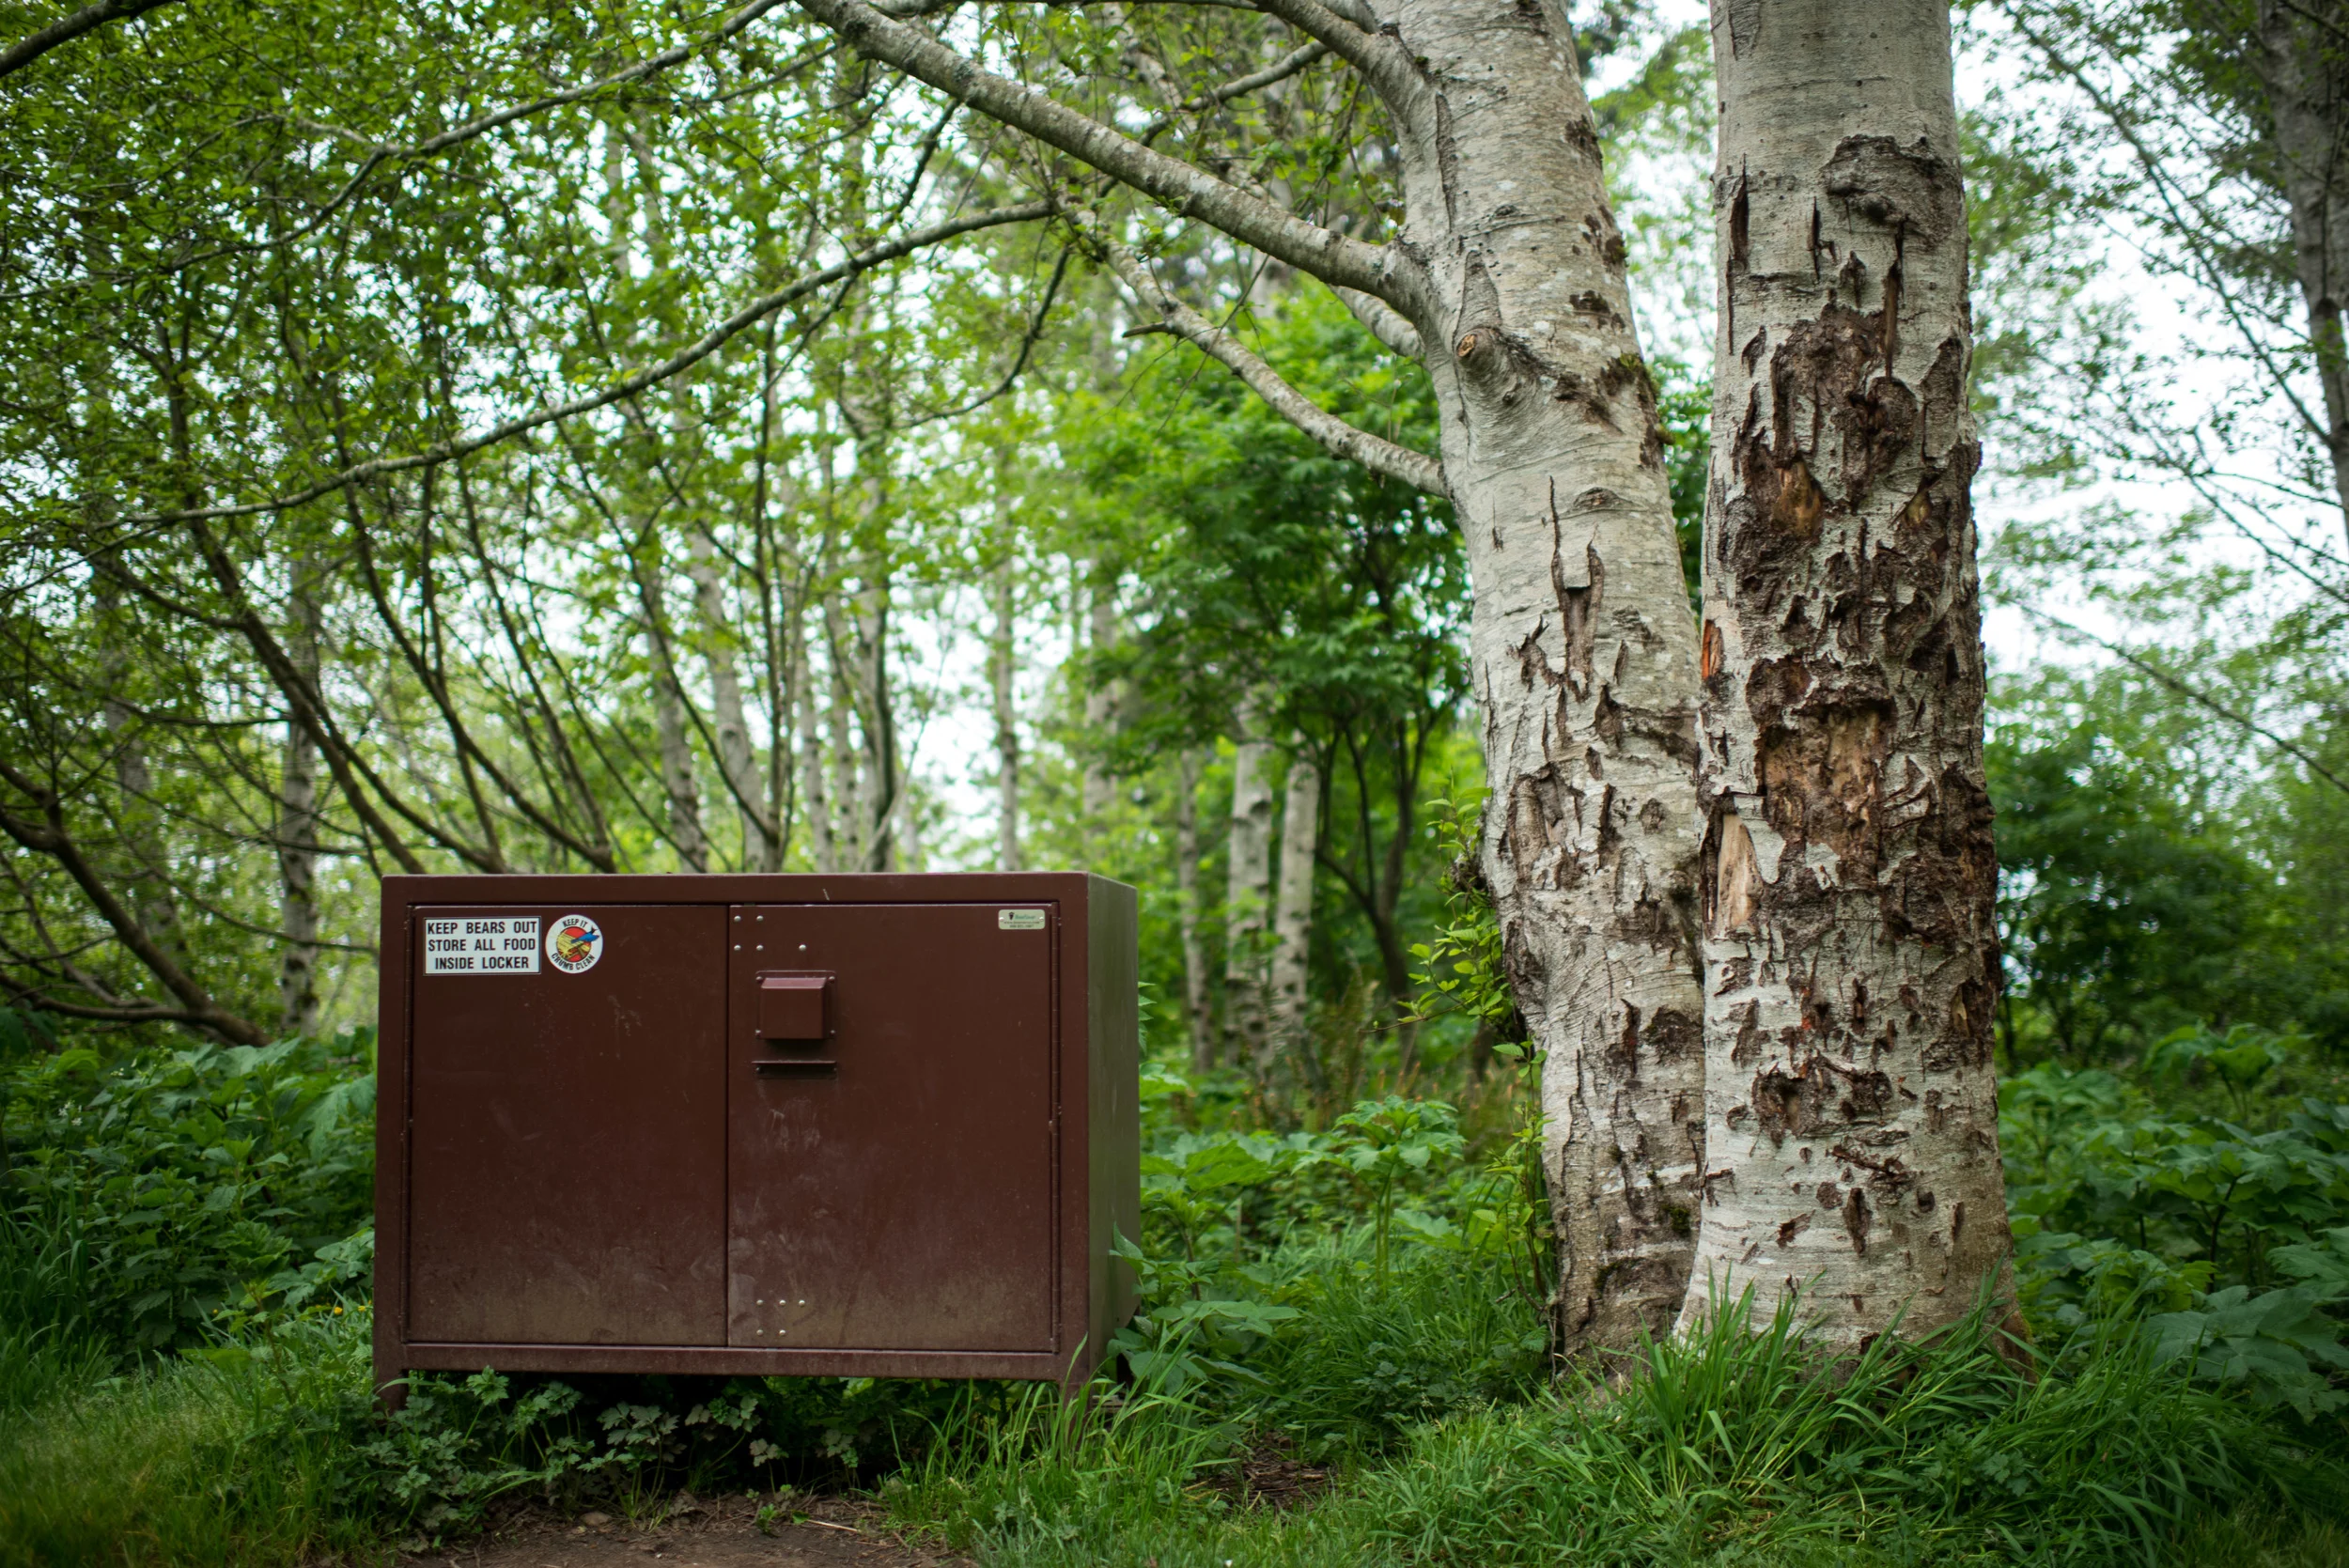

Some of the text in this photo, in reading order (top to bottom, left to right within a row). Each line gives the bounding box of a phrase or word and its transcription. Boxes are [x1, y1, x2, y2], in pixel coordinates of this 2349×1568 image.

[428, 921, 537, 934] KEEP BEARS OUT
[562, 918, 580, 927] KEEP
[428, 938, 536, 952] STORE ALL FOOD
[435, 956, 529, 970] INSIDE LOCKER
[551, 953, 596, 970] CRUMB CLEAN
